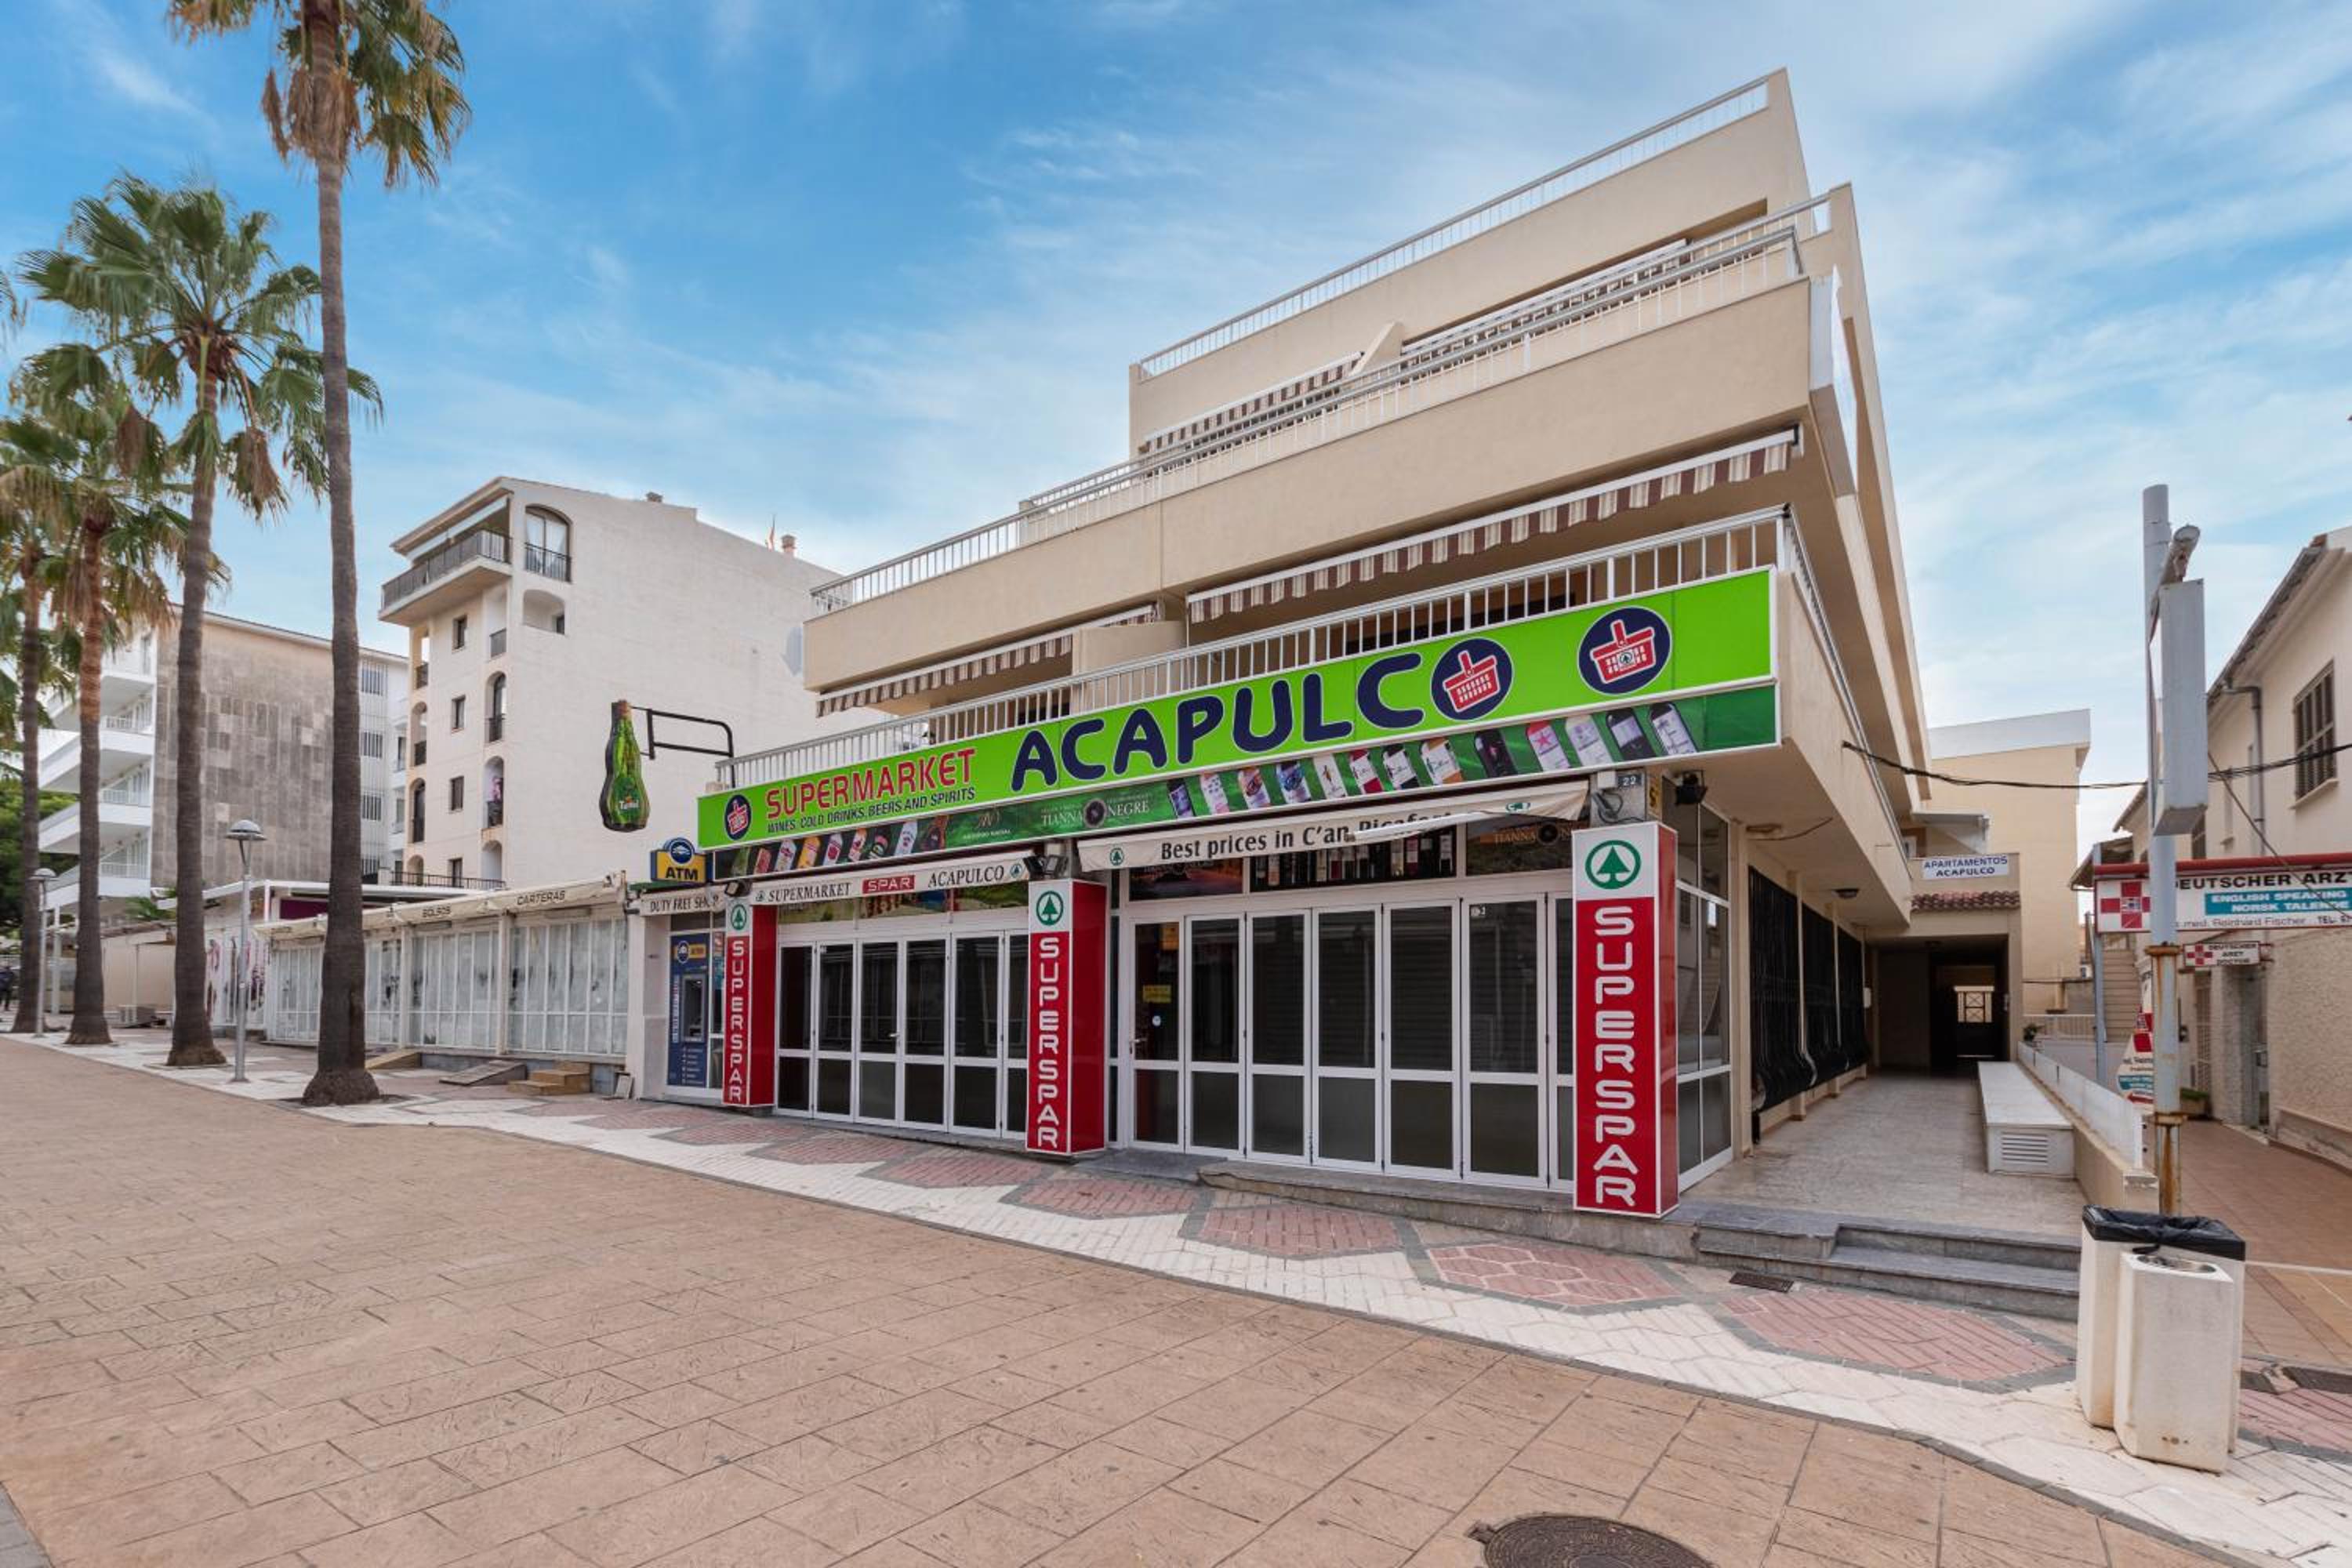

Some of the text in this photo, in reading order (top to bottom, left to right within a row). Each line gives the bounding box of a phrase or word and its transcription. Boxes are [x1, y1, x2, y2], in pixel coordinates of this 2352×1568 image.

[765, 749, 975, 818] SUPERMARKET
[800, 815, 824, 829] COLD
[869, 800, 902, 816] BEERS
[905, 796, 927, 811] AND
[931, 786, 975, 807] SPIRITS
[1107, 800, 1150, 816] NEGRE
[1161, 826, 1349, 860] Best prices in C'an
[1924, 855, 2008, 869] APARTAMENTOS
[665, 866, 699, 880] ATM
[1936, 866, 1995, 877] ACAPULCO
[768, 865, 1004, 902] SUPERMARKET SPAR ACAPULCO
[2175, 874, 2291, 890] EUTSCHER
[517, 891, 565, 906] CARTERAS
[651, 899, 671, 913] DUTY
[674, 898, 691, 910] FREE
[2212, 893, 2270, 902] ENGLISH
[2232, 902, 2279, 912] NORSK
[729, 941, 746, 1102] SUPERSPAR
[1037, 937, 1059, 1149] SUPERSPAR
[1593, 906, 1639, 1207] SUPERSPAR
